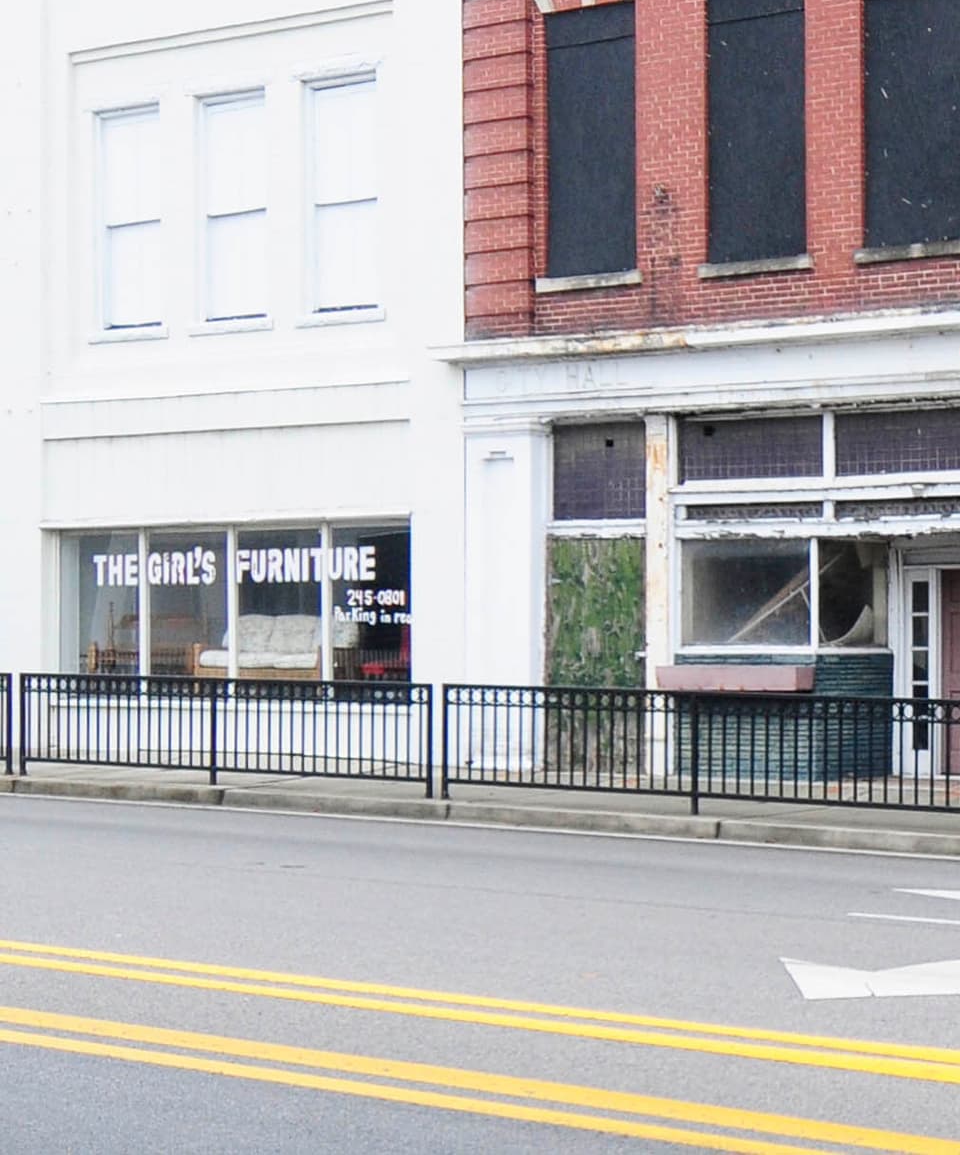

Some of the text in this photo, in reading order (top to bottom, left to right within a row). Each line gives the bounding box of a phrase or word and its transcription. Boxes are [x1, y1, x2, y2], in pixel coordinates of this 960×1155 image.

[565, 359, 630, 389] HALL
[93, 554, 138, 586] THE
[236, 546, 377, 583] FURNITURE
[346, 589, 406, 606] 245-0801
[380, 609, 391, 624] in
